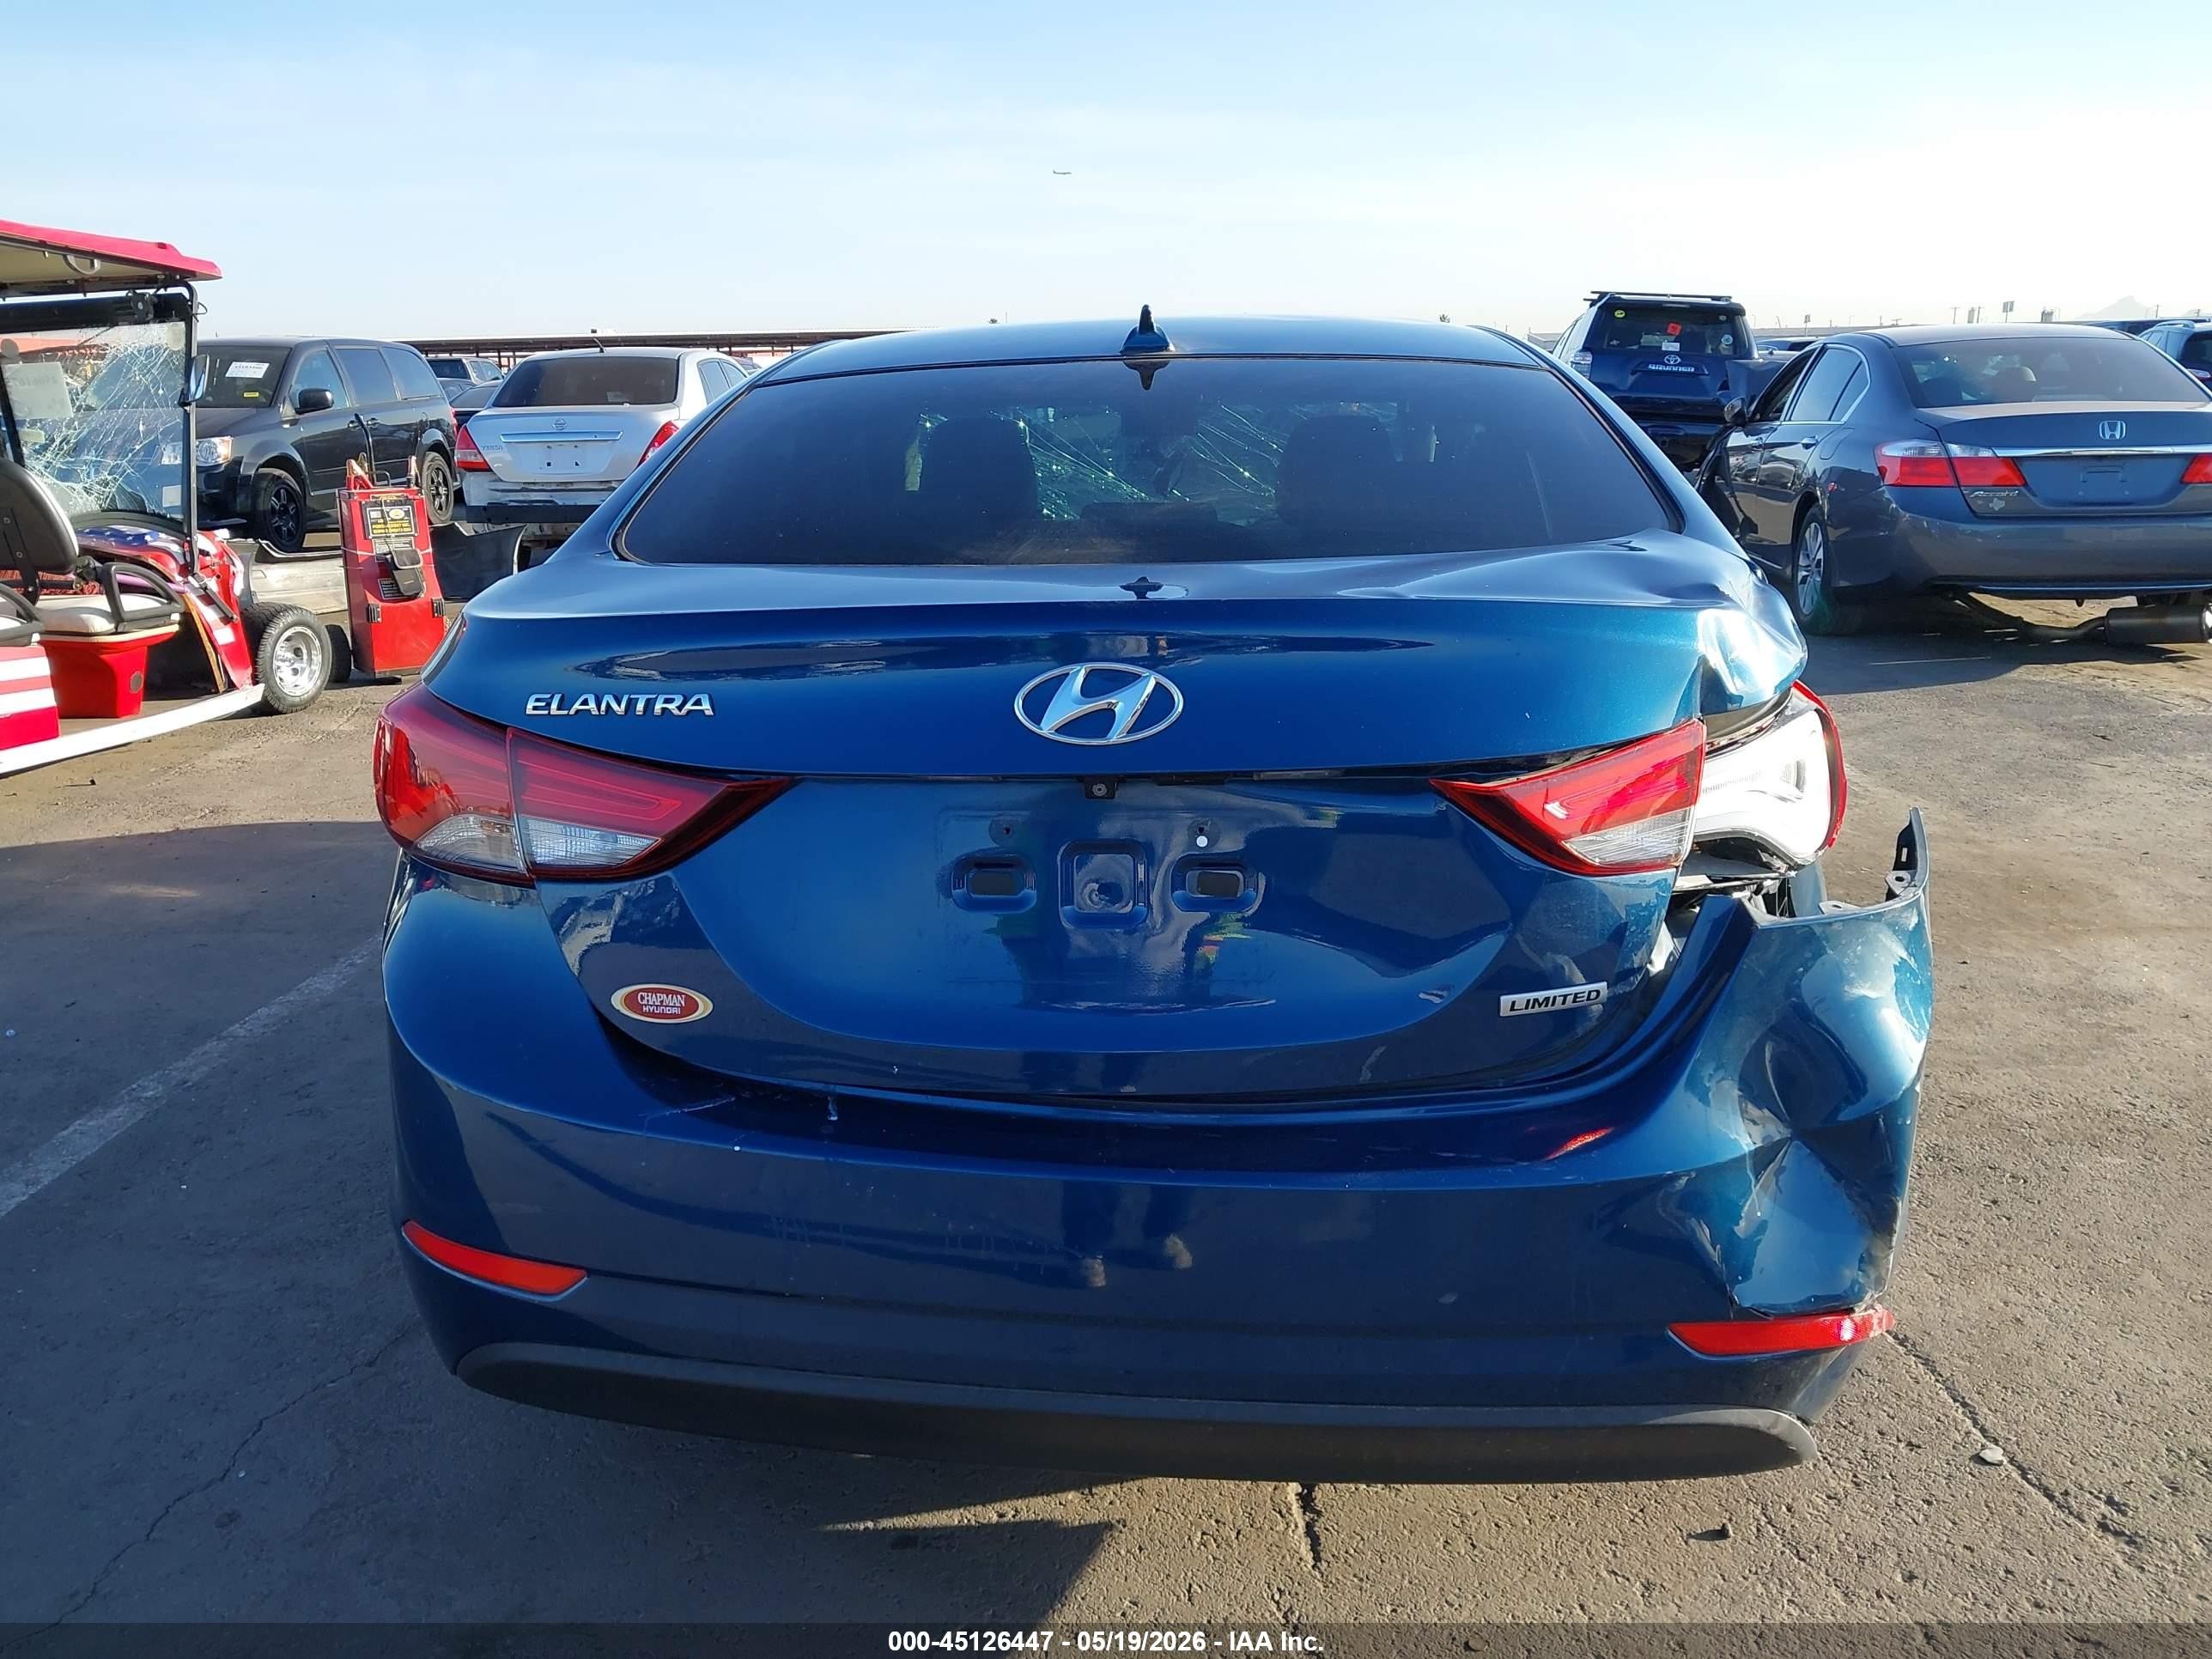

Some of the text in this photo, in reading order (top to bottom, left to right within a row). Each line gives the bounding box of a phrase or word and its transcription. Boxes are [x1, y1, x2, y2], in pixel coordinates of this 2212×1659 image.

[526, 693, 715, 716] ELANTRA
[637, 992, 686, 1007] CHAPMAN
[1509, 989, 1601, 1012] LIMITED
[642, 1005, 681, 1015] HYUNDAI
